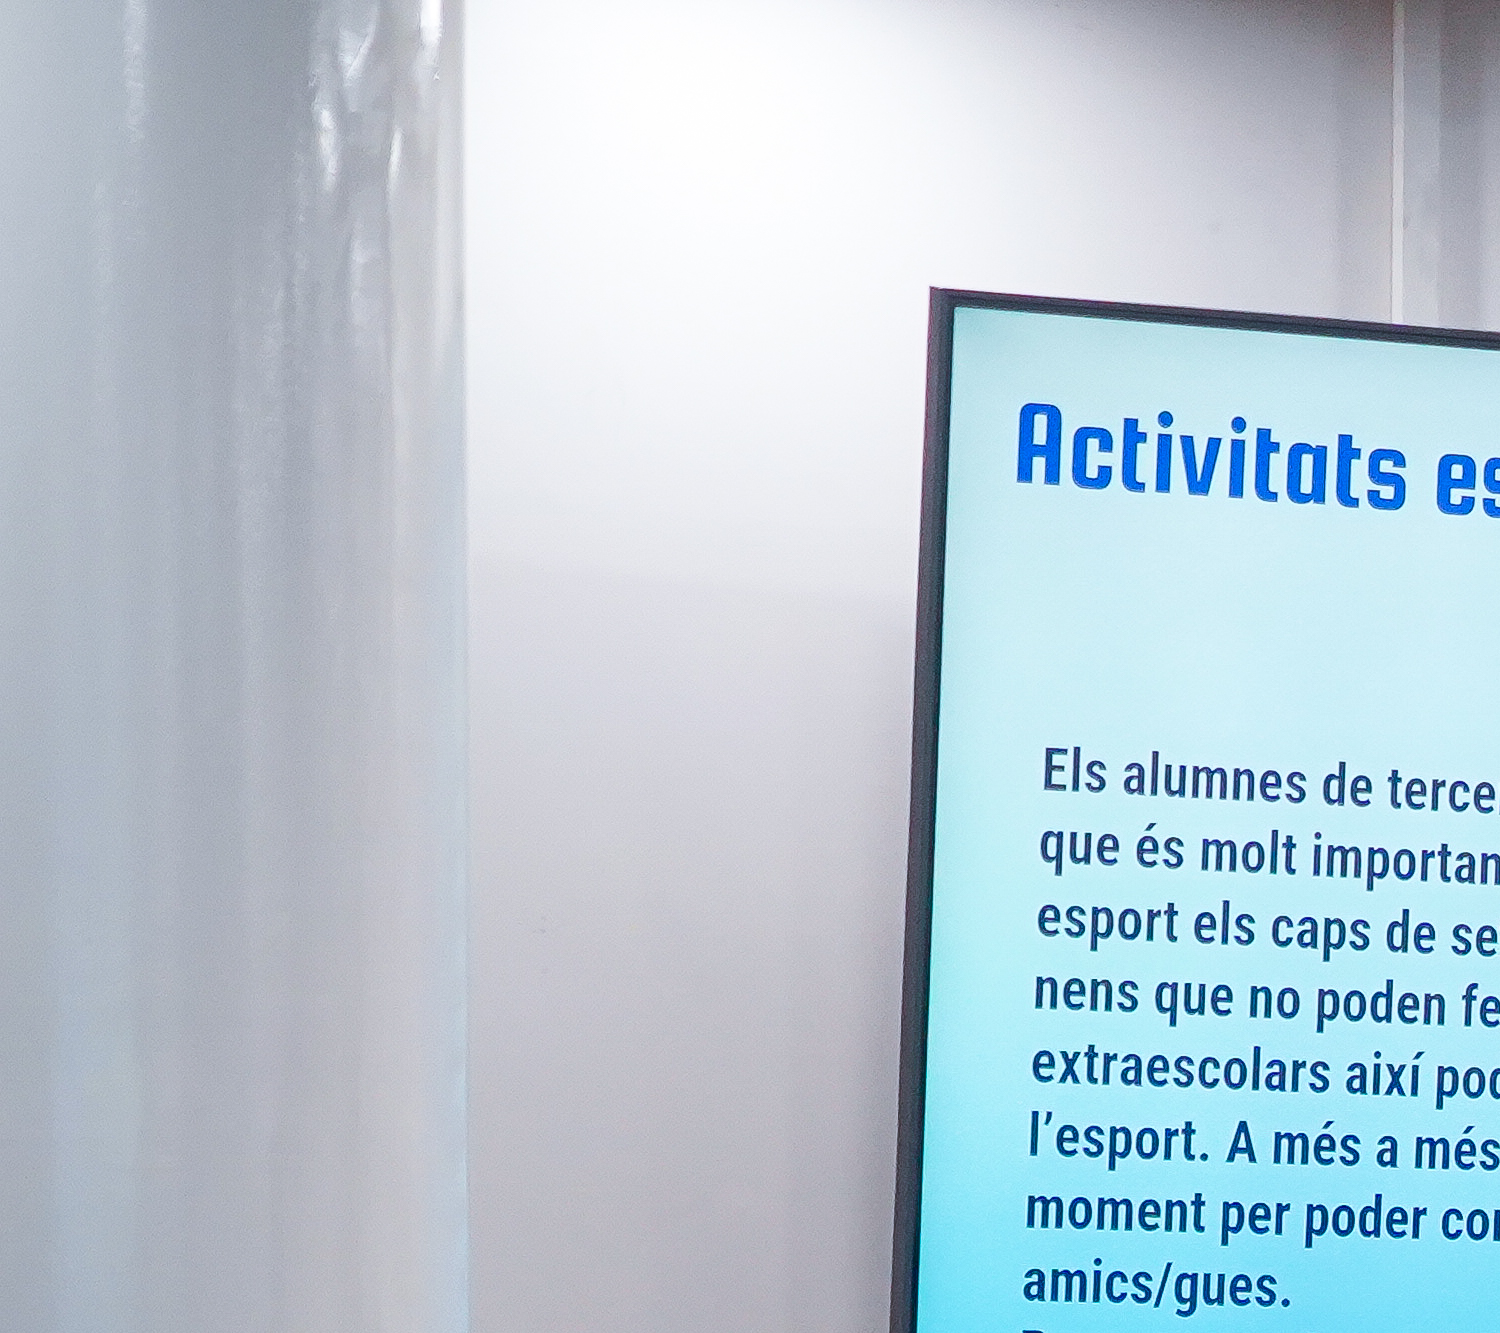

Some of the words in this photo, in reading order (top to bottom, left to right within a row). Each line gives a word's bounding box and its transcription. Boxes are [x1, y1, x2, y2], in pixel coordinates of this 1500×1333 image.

[1016, 402, 1407, 511] Activitats
[1043, 745, 1107, 794] Els
[1123, 750, 1307, 804] alumnes
[1322, 760, 1373, 808] de
[1040, 830, 1120, 877] que
[1135, 822, 1185, 870] és
[1200, 829, 1298, 876] molt
[1037, 901, 1179, 952] esport
[1193, 899, 1256, 947] els
[1271, 915, 1371, 963] caps
[1386, 908, 1436, 955] de
[1034, 975, 1139, 1013] nens
[1154, 981, 1234, 1028] que
[1249, 985, 1301, 1020] no
[1315, 978, 1446, 1034] poden
[1031, 1043, 1331, 1094] extraescolars
[1345, 1050, 1426, 1098] així
[1029, 1110, 1209, 1172] l'esport.
[1225, 1120, 1258, 1164] A
[1272, 1120, 1362, 1167] més
[1376, 1135, 1400, 1169] a
[1026, 1192, 1207, 1234] moment
[1220, 1200, 1292, 1247] per
[1304, 1193, 1428, 1249] poder
[1022, 1257, 1291, 1318] amics/gues.
